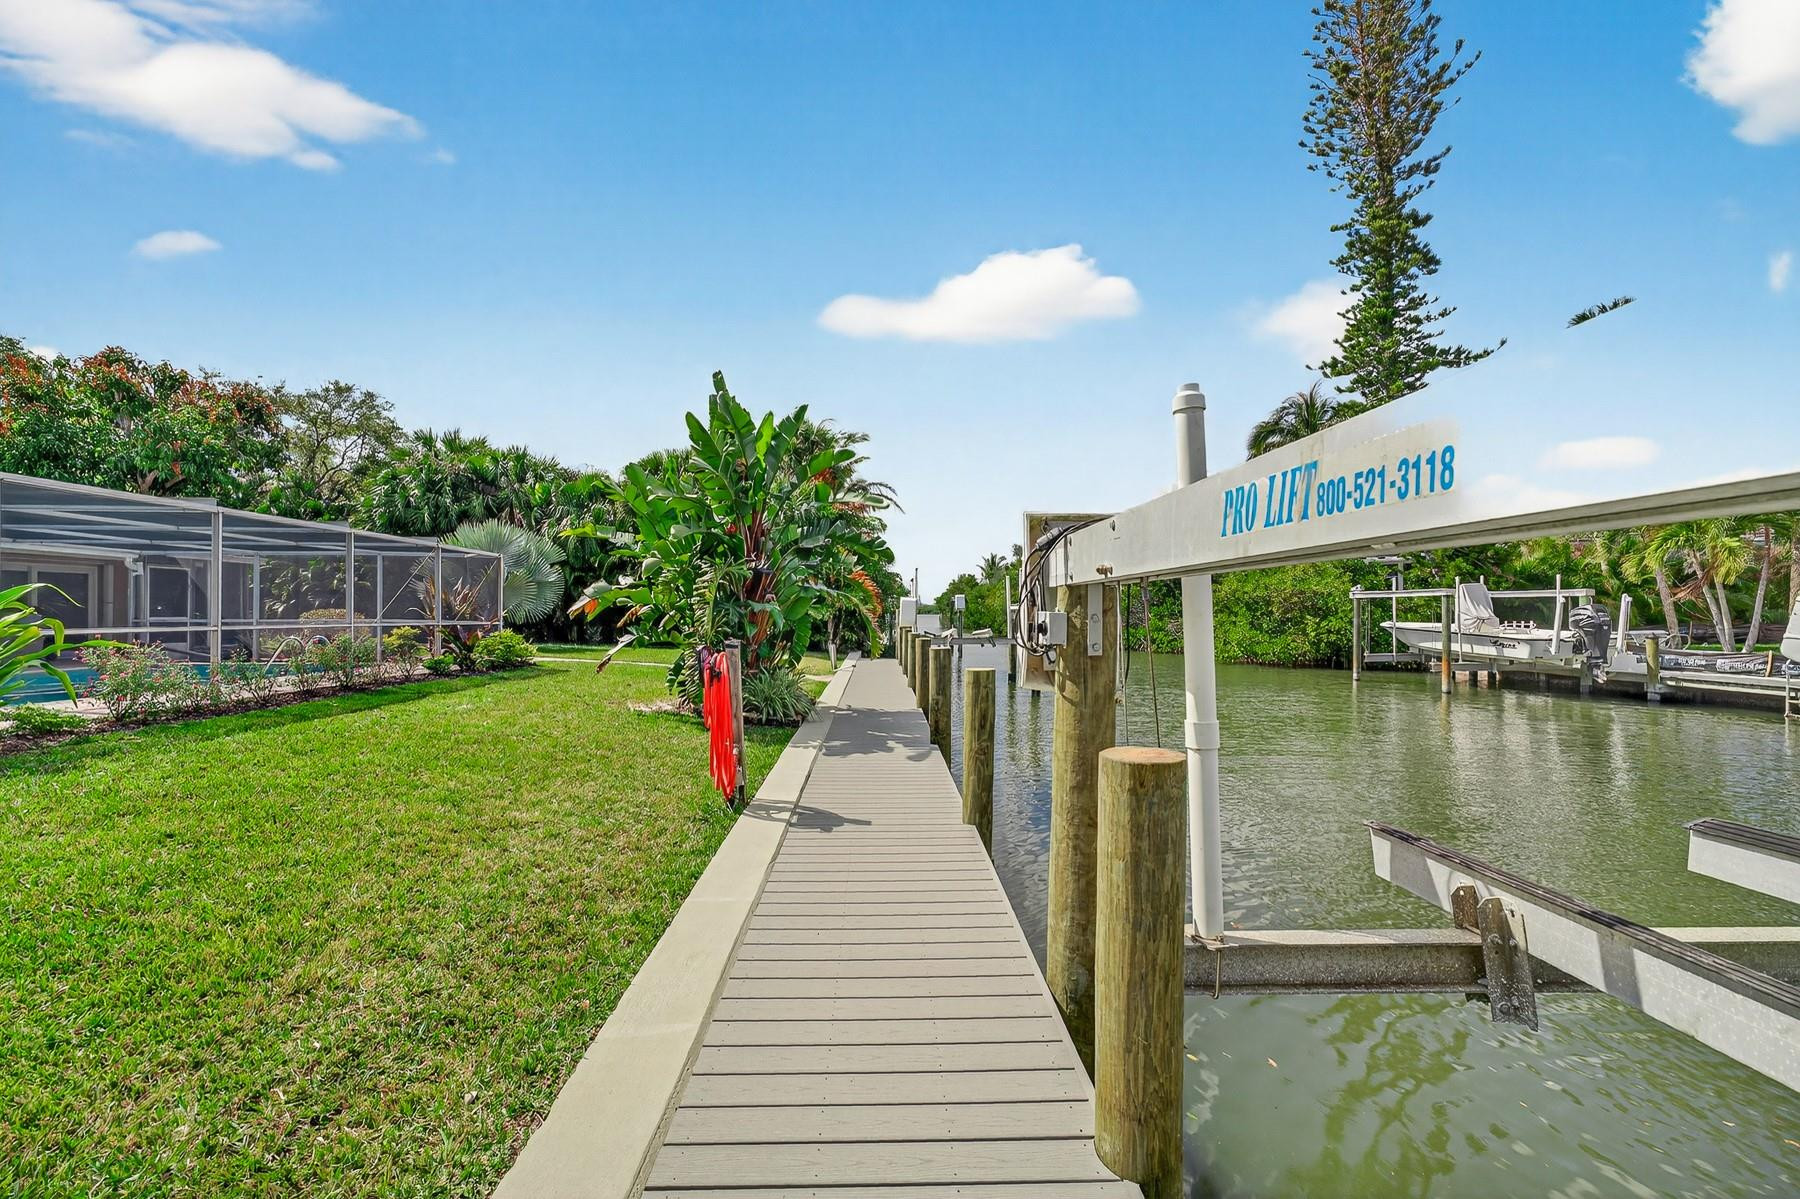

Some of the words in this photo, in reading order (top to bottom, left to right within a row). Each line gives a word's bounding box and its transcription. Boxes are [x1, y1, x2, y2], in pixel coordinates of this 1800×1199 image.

[1221, 483, 1258, 537] PRO
[1264, 460, 1318, 528] LIFT
[1316, 444, 1455, 517] 800-521-3118
